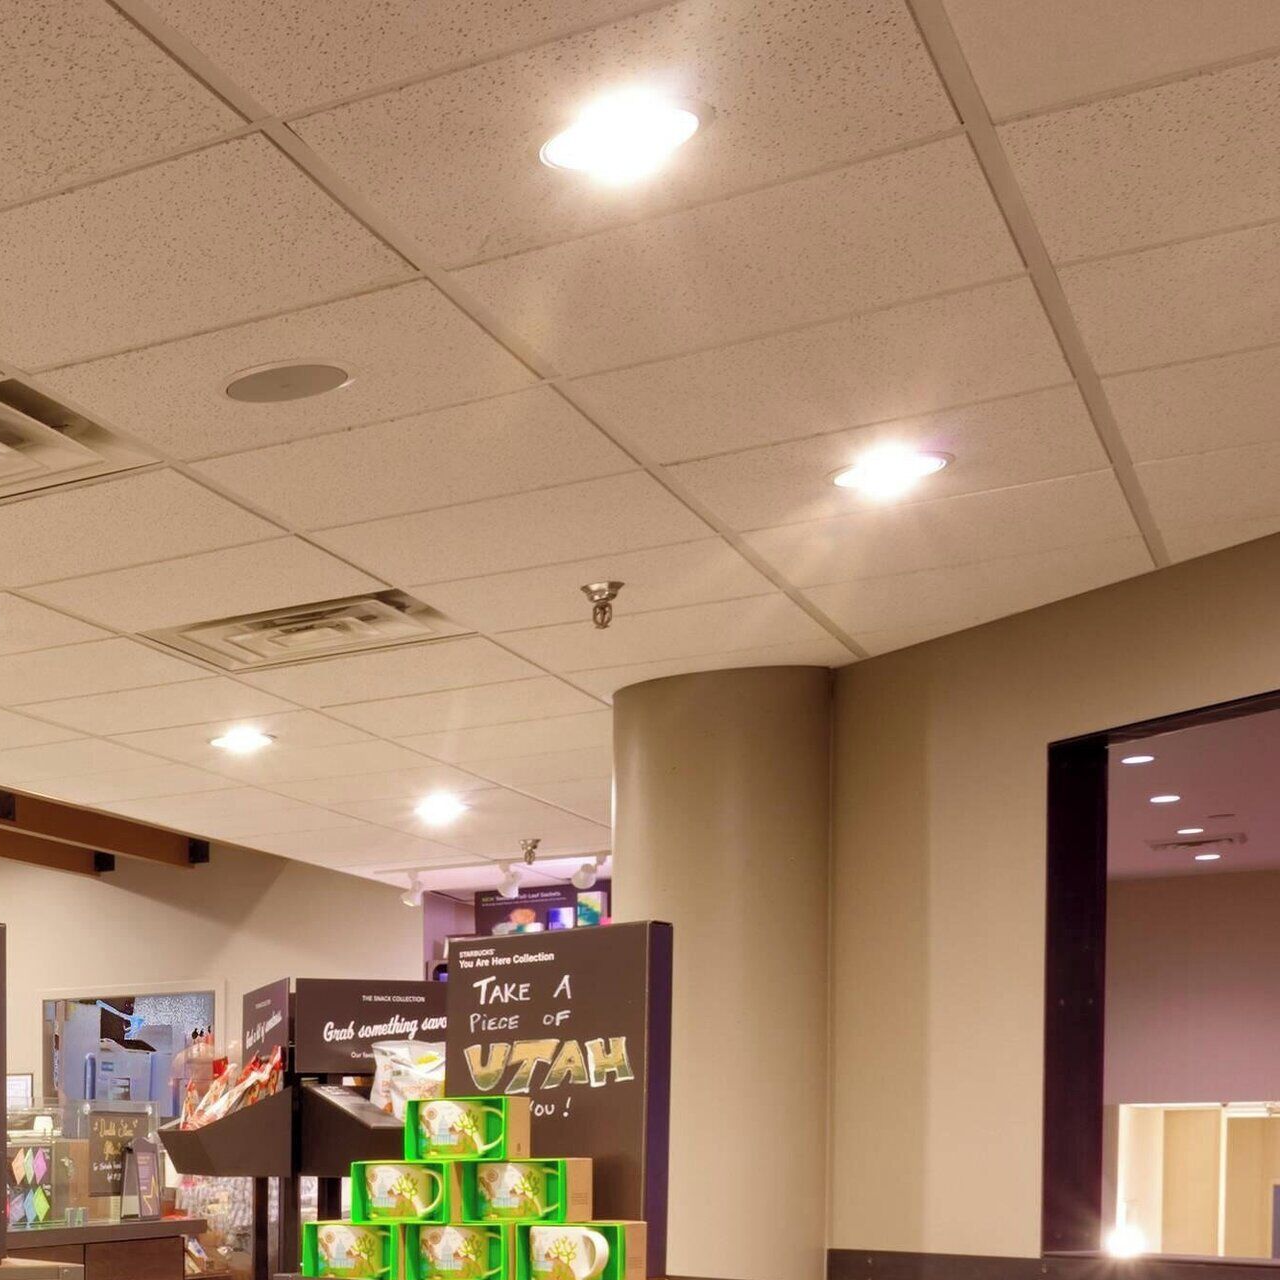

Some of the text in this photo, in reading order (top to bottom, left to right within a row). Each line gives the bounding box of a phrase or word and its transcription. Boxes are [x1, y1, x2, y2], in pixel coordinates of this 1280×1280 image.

[459, 949, 496, 959] STARBUCKS
[459, 952, 555, 969] You Are Here Collection
[392, 995, 426, 1003] COLLECTION
[472, 974, 572, 1005] TAKE A
[323, 1014, 448, 1042] Grab something savo
[463, 1036, 635, 1095] UTAH
